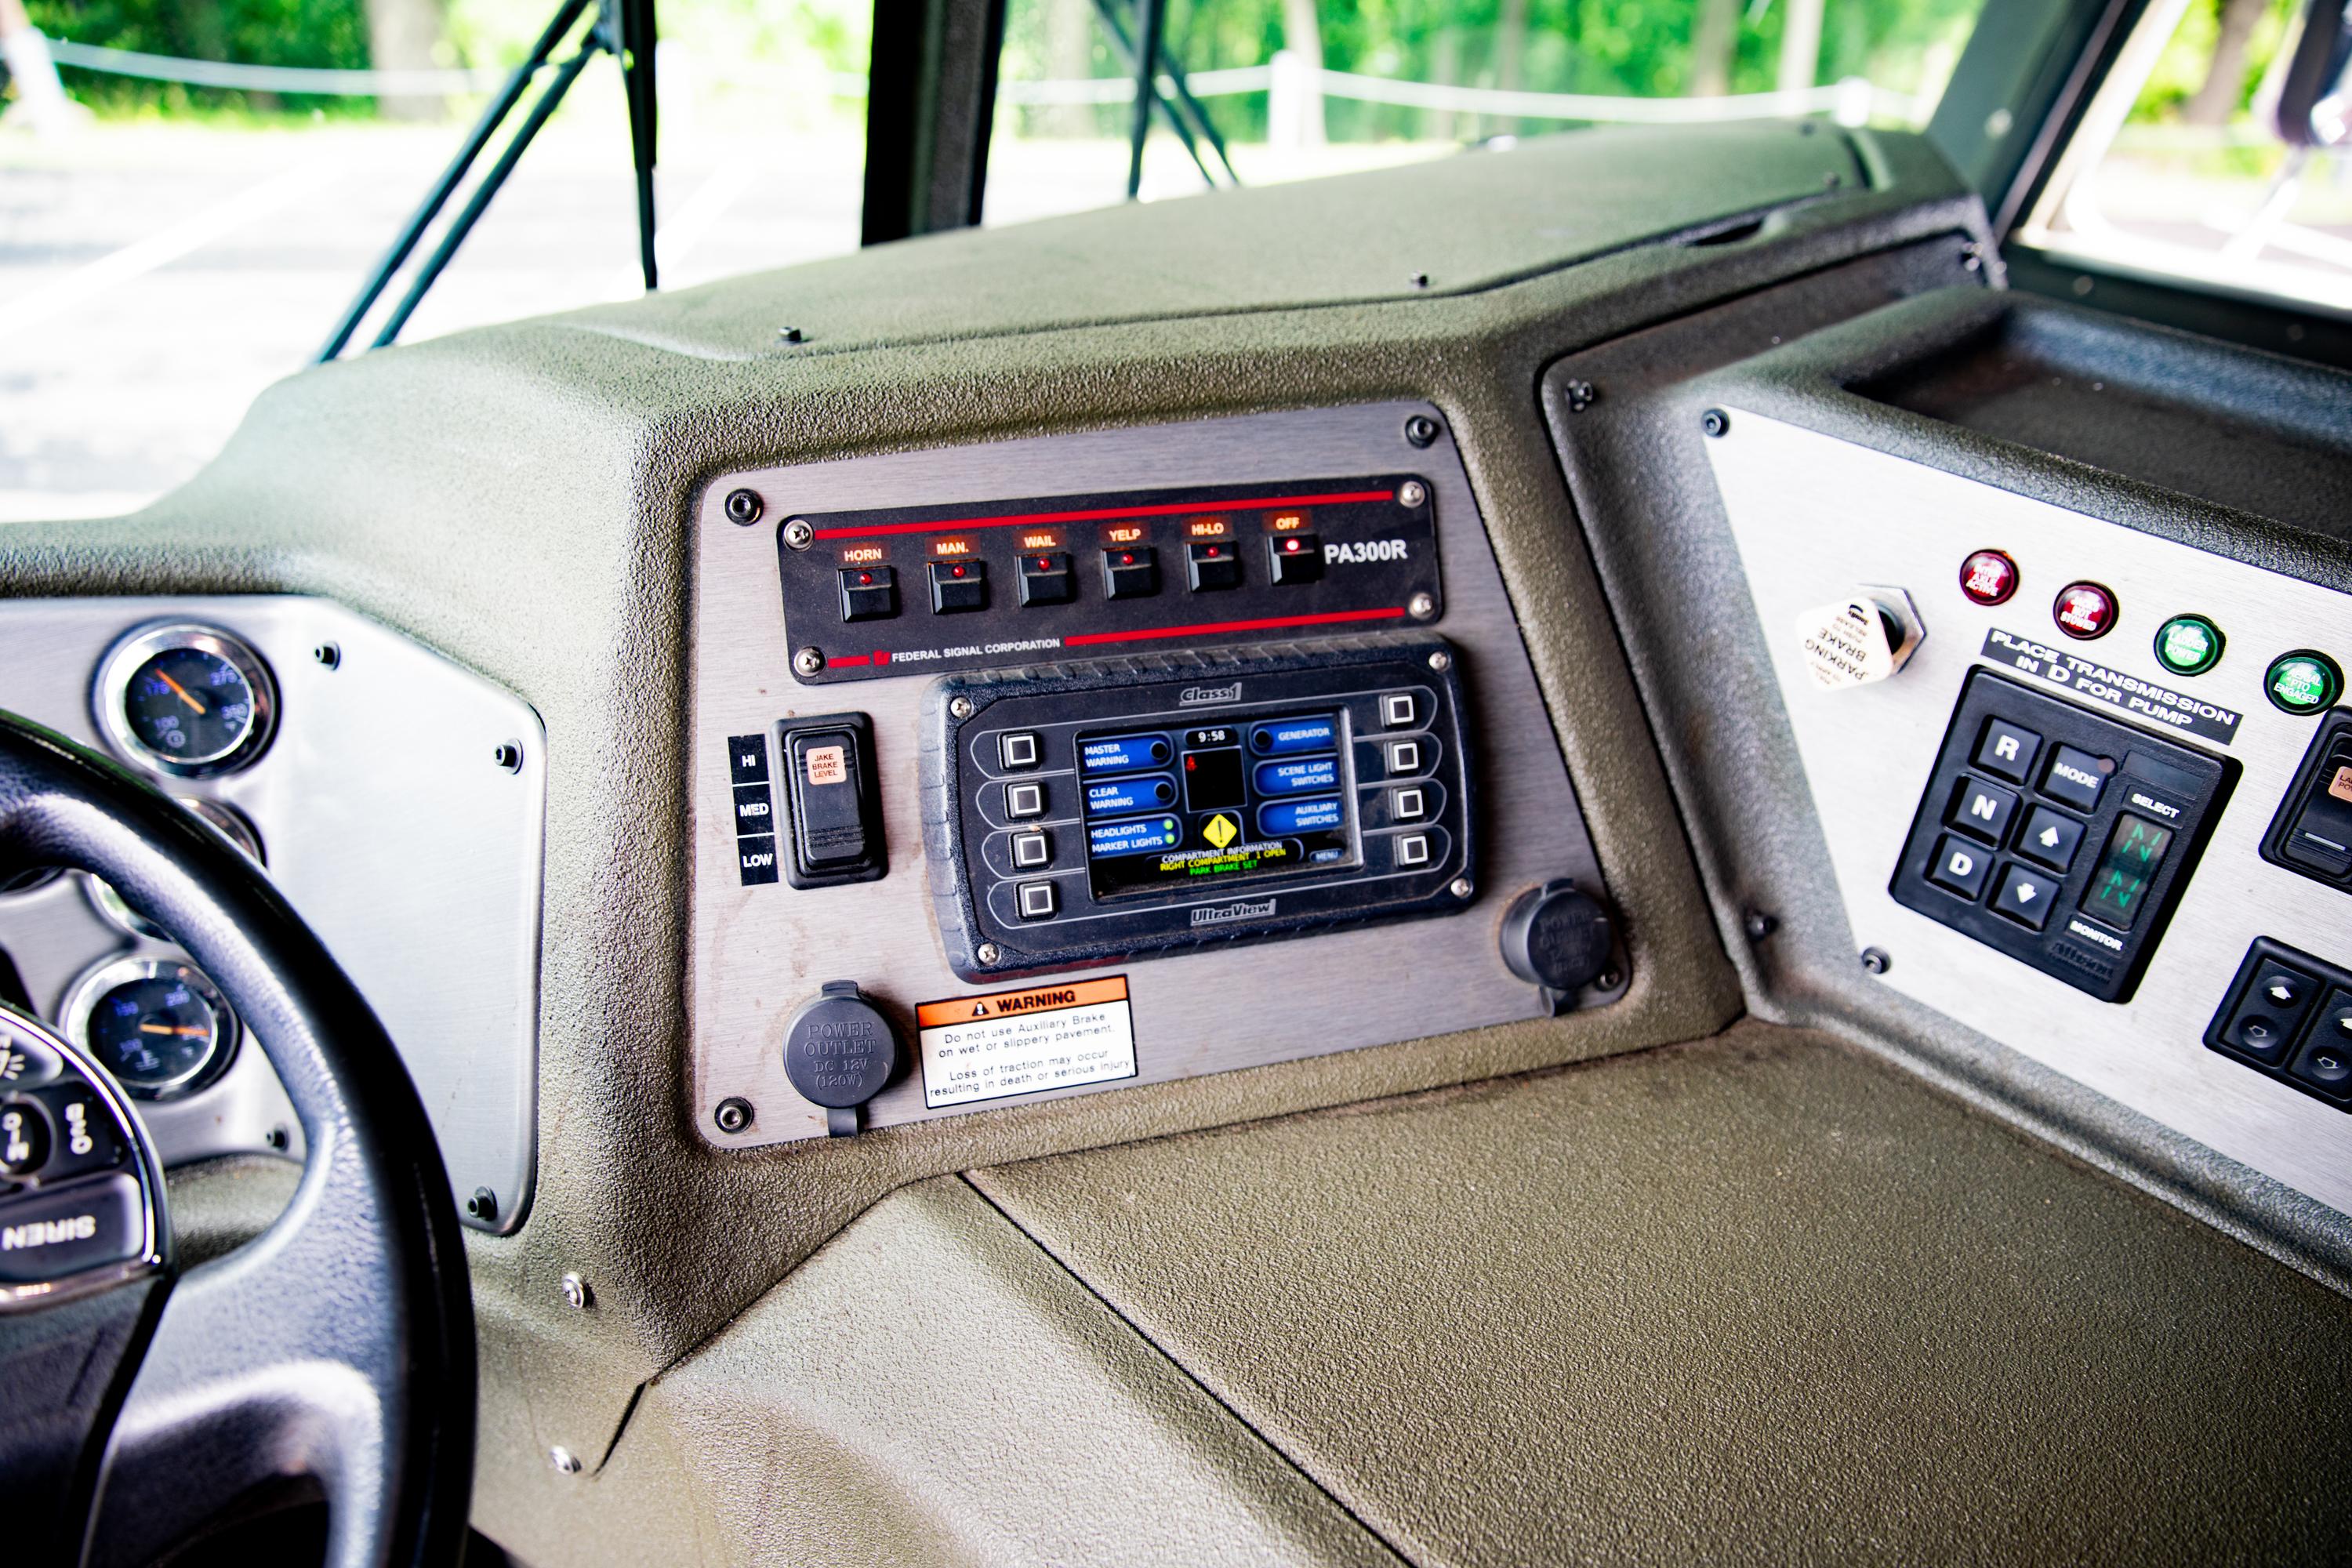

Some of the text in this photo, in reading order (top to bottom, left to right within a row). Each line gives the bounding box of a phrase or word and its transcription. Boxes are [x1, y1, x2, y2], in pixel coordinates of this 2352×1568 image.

[1192, 522, 1224, 535] HI-LO
[1276, 517, 1300, 530] OFF
[1024, 534, 1056, 548] WAIL
[1109, 528, 1141, 541] YELP
[844, 549, 882, 562] HORN
[937, 542, 969, 555] MAN.
[1324, 539, 1408, 564] PA300R
[2060, 611, 2097, 631] STOWED
[891, 638, 1060, 662] FEDERAL SIGNAL CORPORATION
[1817, 627, 1866, 662] BRAKE
[2165, 643, 2201, 662] POWER
[1805, 638, 1866, 681] PARKING
[1991, 630, 2236, 726] PLACE TRANSMISSION
[2291, 678, 2311, 691] PTO
[2016, 656, 2194, 725] IN D FOR PUMP
[2274, 682, 2319, 704] ENGAGED
[1198, 730, 1225, 743] 9:58
[1278, 728, 1330, 741] GENERATOR
[1084, 743, 1121, 756] MASTER
[1994, 734, 2020, 760] R
[742, 754, 756, 767] HI
[812, 761, 838, 771] BRAKE
[815, 753, 834, 762] JAKE
[1086, 755, 1129, 768] WARNING
[814, 768, 838, 778] LEVEL
[1278, 761, 1333, 777] SCENE LIGHT
[2053, 761, 2100, 789] MODE
[1291, 774, 1334, 786] SWITCHES
[1089, 786, 1119, 798] CLEAR
[739, 803, 769, 817] MED
[1090, 797, 1134, 810] WARNING
[1295, 802, 1338, 815] AUXILIARY
[1971, 794, 1998, 821] N
[2131, 793, 2180, 818] SELECT
[1295, 814, 1339, 827] SWITCHES
[1091, 825, 1147, 838] HEADLIGHTS
[1091, 837, 1163, 853] MARKER LIGHTS
[2122, 823, 2162, 862] N
[742, 853, 773, 867] LOW
[1160, 860, 1185, 872] RIGHT
[1188, 852, 1250, 868] COMPARTMENT
[1264, 848, 1287, 858] OPEN
[1161, 841, 1283, 863] COMPARTMENT INFORMATION
[1316, 851, 1338, 860] MENU
[1189, 859, 1258, 876] PARK BRAKE SET
[1948, 851, 1973, 877] D
[2101, 869, 2140, 908] N
[1192, 902, 1272, 924] UltraView
[2069, 920, 2123, 951] MONITOR
[996, 989, 1076, 1013] WARNING
[806, 1022, 874, 1040] POWER
[945, 1013, 1105, 1044] Do not use Auxiliary Brake
[804, 1039, 877, 1058] OUTLET
[938, 1024, 1115, 1058] on wet or slippery pavement.
[814, 1058, 870, 1074] DC 12V
[949, 1049, 1109, 1080] Loss of traction may occur
[815, 1072, 863, 1091] (120W)
[930, 1081, 980, 1098] resulting
[985, 1078, 994, 1088] in
[1000, 1073, 1032, 1087] death
[1037, 1072, 1049, 1081] or
[1054, 1065, 1095, 1078] serious
[2, 1214, 96, 1251] SIREN
